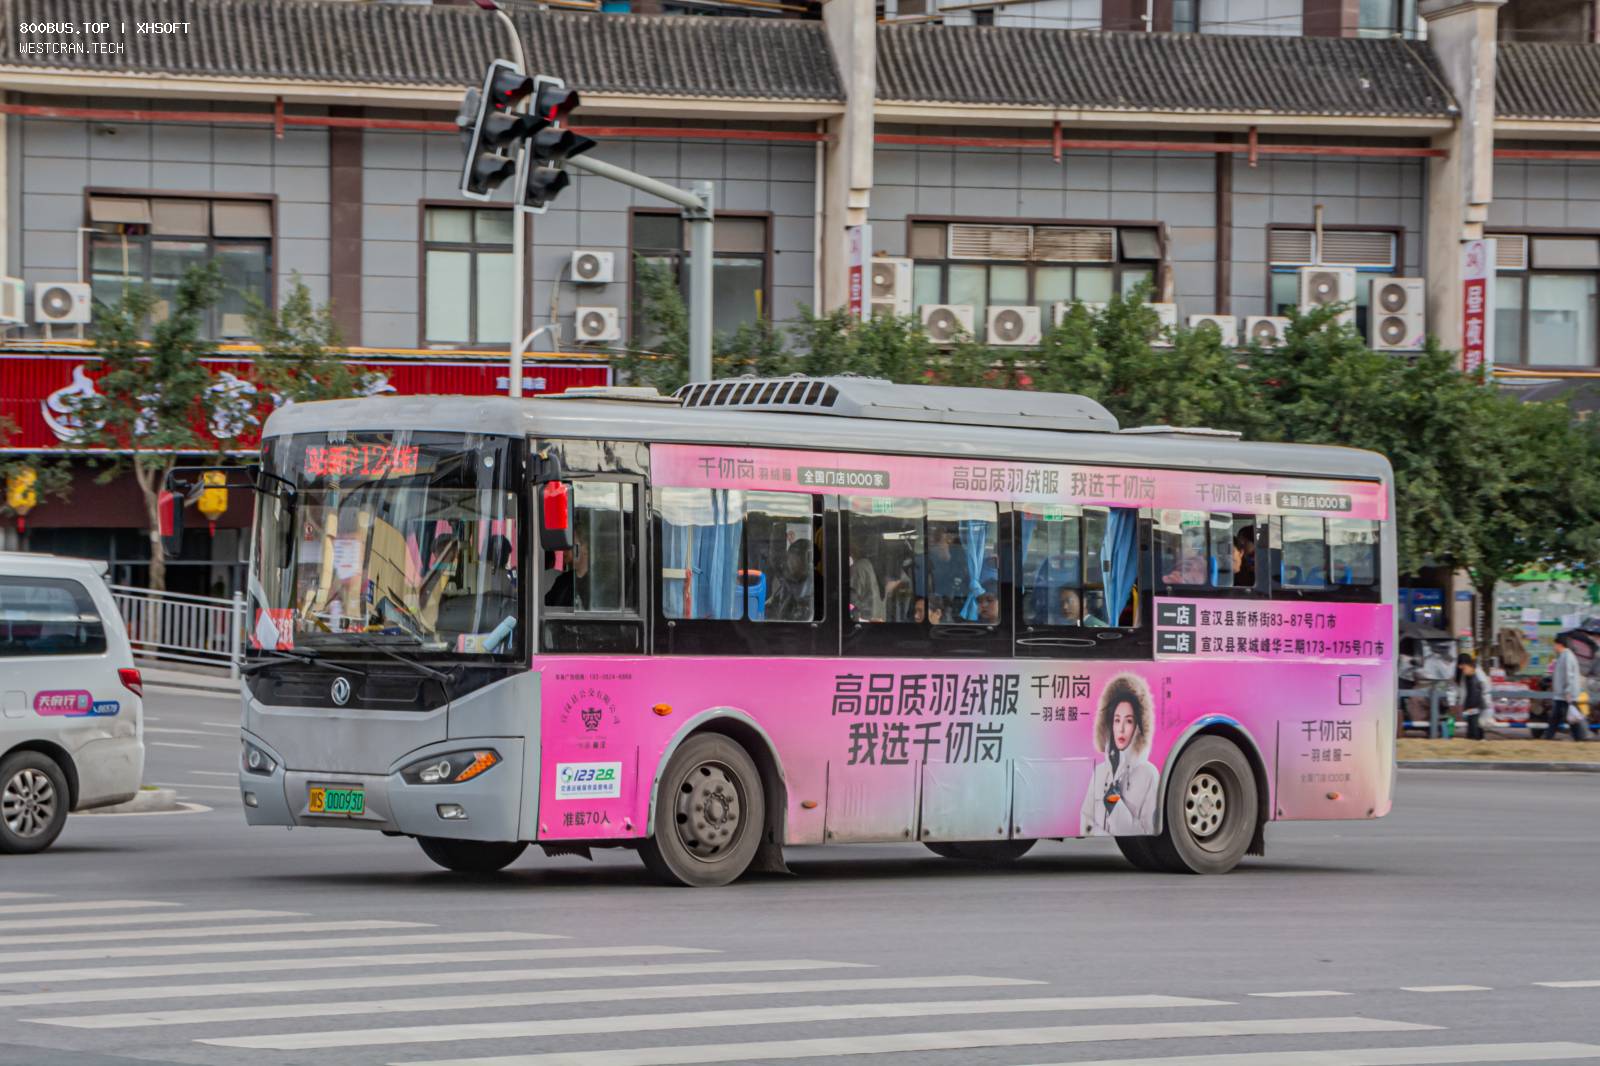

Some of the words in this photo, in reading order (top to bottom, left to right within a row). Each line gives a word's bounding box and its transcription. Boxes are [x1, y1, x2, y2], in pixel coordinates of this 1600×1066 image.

[698, 457, 755, 479] 千仞岗
[803, 469, 884, 486] 全国门店1000家
[952, 466, 1059, 494] 高品质羽绒服
[1070, 472, 1155, 499] 我选千仞岗
[1195, 483, 1241, 504] 千仞岗
[1281, 493, 1347, 510] 全国门店1000家
[1163, 605, 1190, 625] 一店
[1200, 610, 1337, 629] 宣汉县新桥街83-87号门市
[1163, 632, 1190, 653] 二店
[832, 673, 1020, 716] 高品质羽绒服
[1030, 675, 1091, 699] 千仞岗
[847, 721, 1004, 765] 我选千仞岗
[1301, 720, 1352, 741] 千仞岗
[574, 768, 615, 781] 12328
[563, 810, 611, 826] 准载70人
